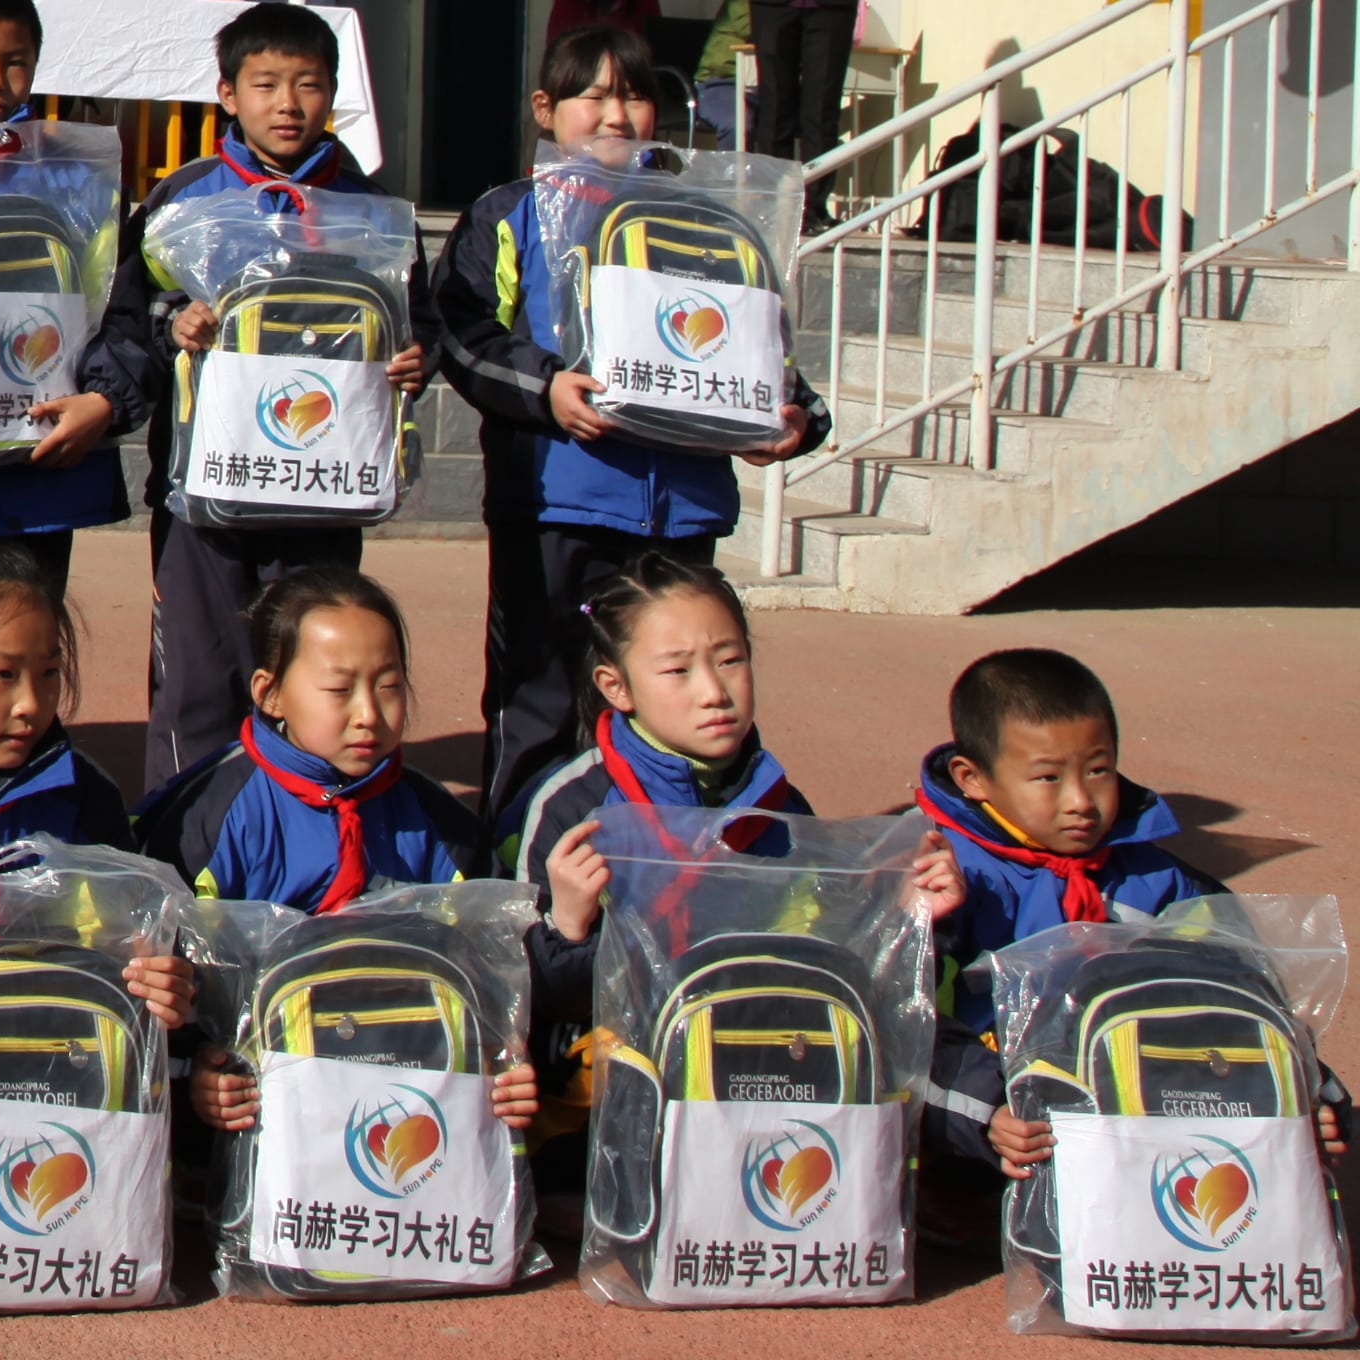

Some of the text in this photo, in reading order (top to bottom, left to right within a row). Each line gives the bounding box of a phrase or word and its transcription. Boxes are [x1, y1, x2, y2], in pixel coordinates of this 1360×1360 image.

[606, 356, 773, 413] 尚赫学习大礼包
[203, 449, 380, 496] 尚赫学习大礼包
[728, 1083, 815, 1101] GEGEBAOBEI
[1161, 1099, 1253, 1118] GEGEBAOBEI
[402, 1179, 421, 1196] SUN
[45, 1217, 66, 1234] SUN
[275, 1197, 496, 1265] 尚赫学习大礼包
[799, 1211, 818, 1229] SUN
[1221, 1206, 1258, 1249] SUN HOPE
[672, 1239, 889, 1289] 尚赫学习大礼包
[1086, 1259, 1326, 1312] 尚赫学习大礼包
